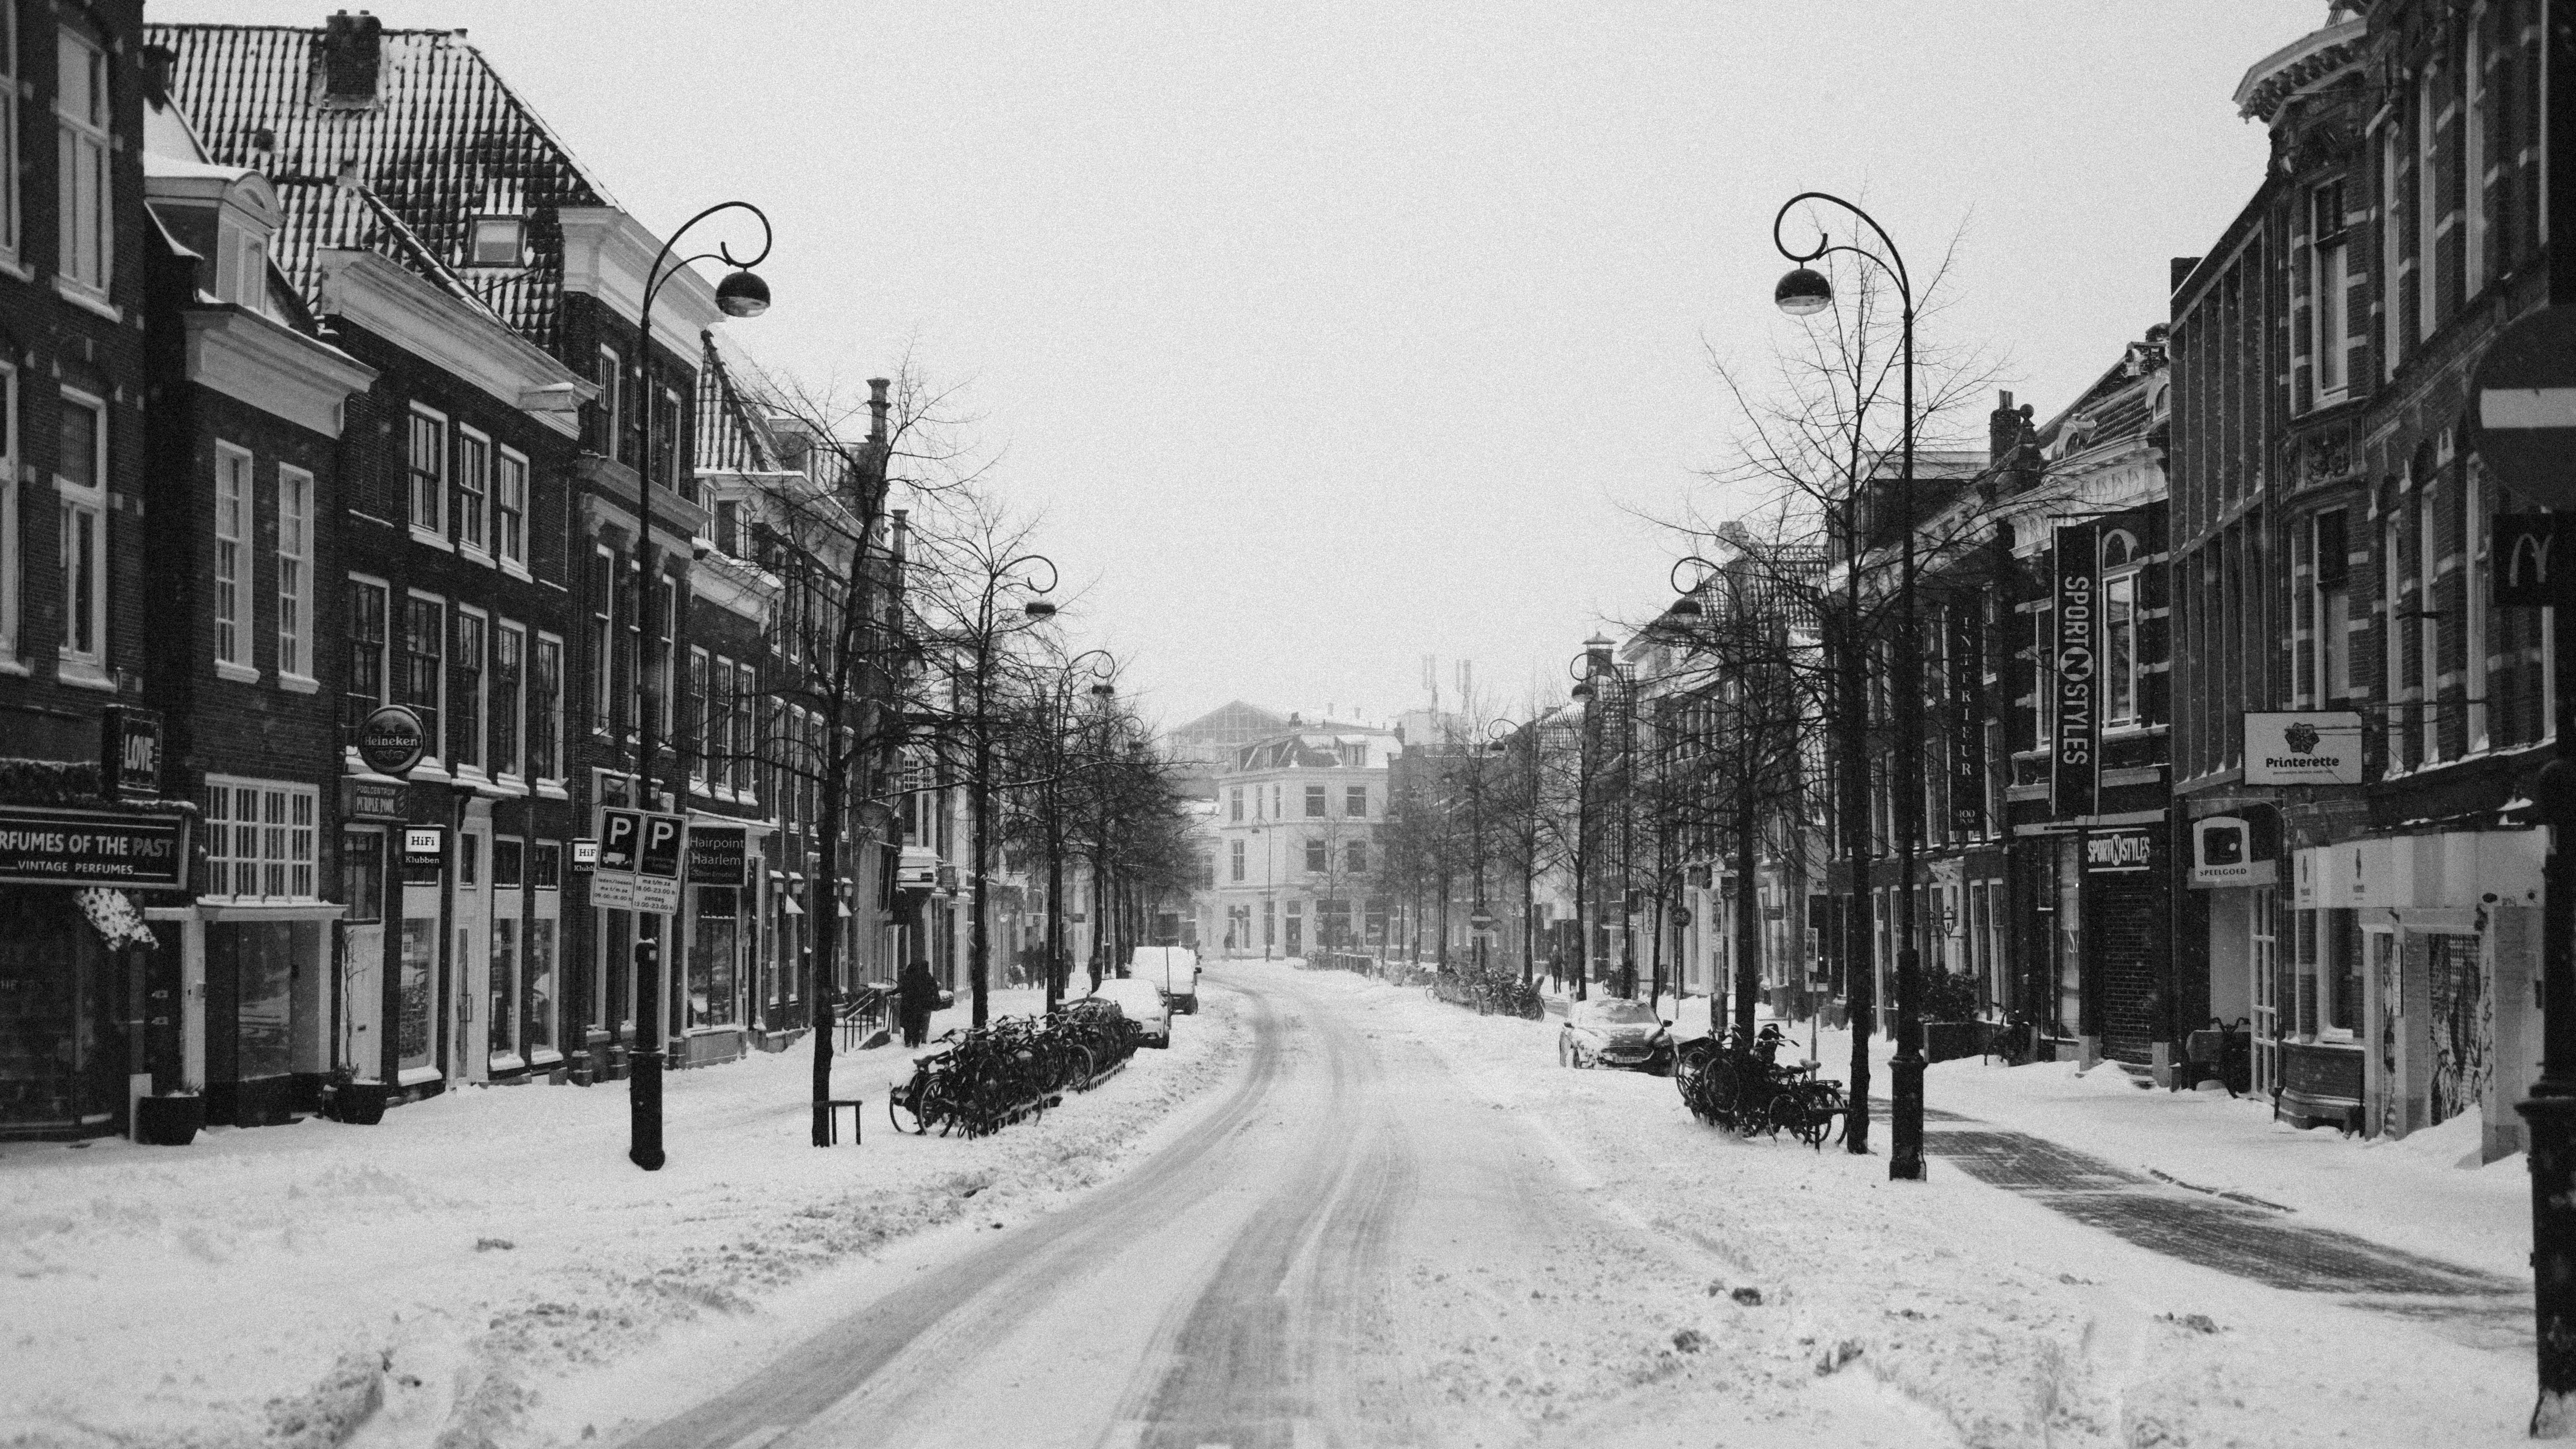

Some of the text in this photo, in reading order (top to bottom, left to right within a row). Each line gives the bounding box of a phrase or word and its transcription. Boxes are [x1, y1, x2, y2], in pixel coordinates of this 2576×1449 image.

[365, 736, 418, 746] Heineken
[124, 734, 154, 772] LOVE
[2266, 757, 2340, 768] Printerette
[356, 797, 395, 813] PURPLE POOL
[1959, 810, 1975, 818] 100
[610, 817, 632, 845] P
[652, 821, 674, 849] P
[69, 834, 92, 854] OF
[96, 835, 128, 856] THE
[132, 838, 174, 858] PAST
[411, 836, 435, 846] HiFi
[690, 836, 744, 850] Hairpoint
[405, 856, 440, 864] Klubben
[691, 852, 741, 865] Haarlem
[18, 860, 134, 875] VINTAGE PERFUMES
[2200, 868, 2246, 876] SPEELGOED
